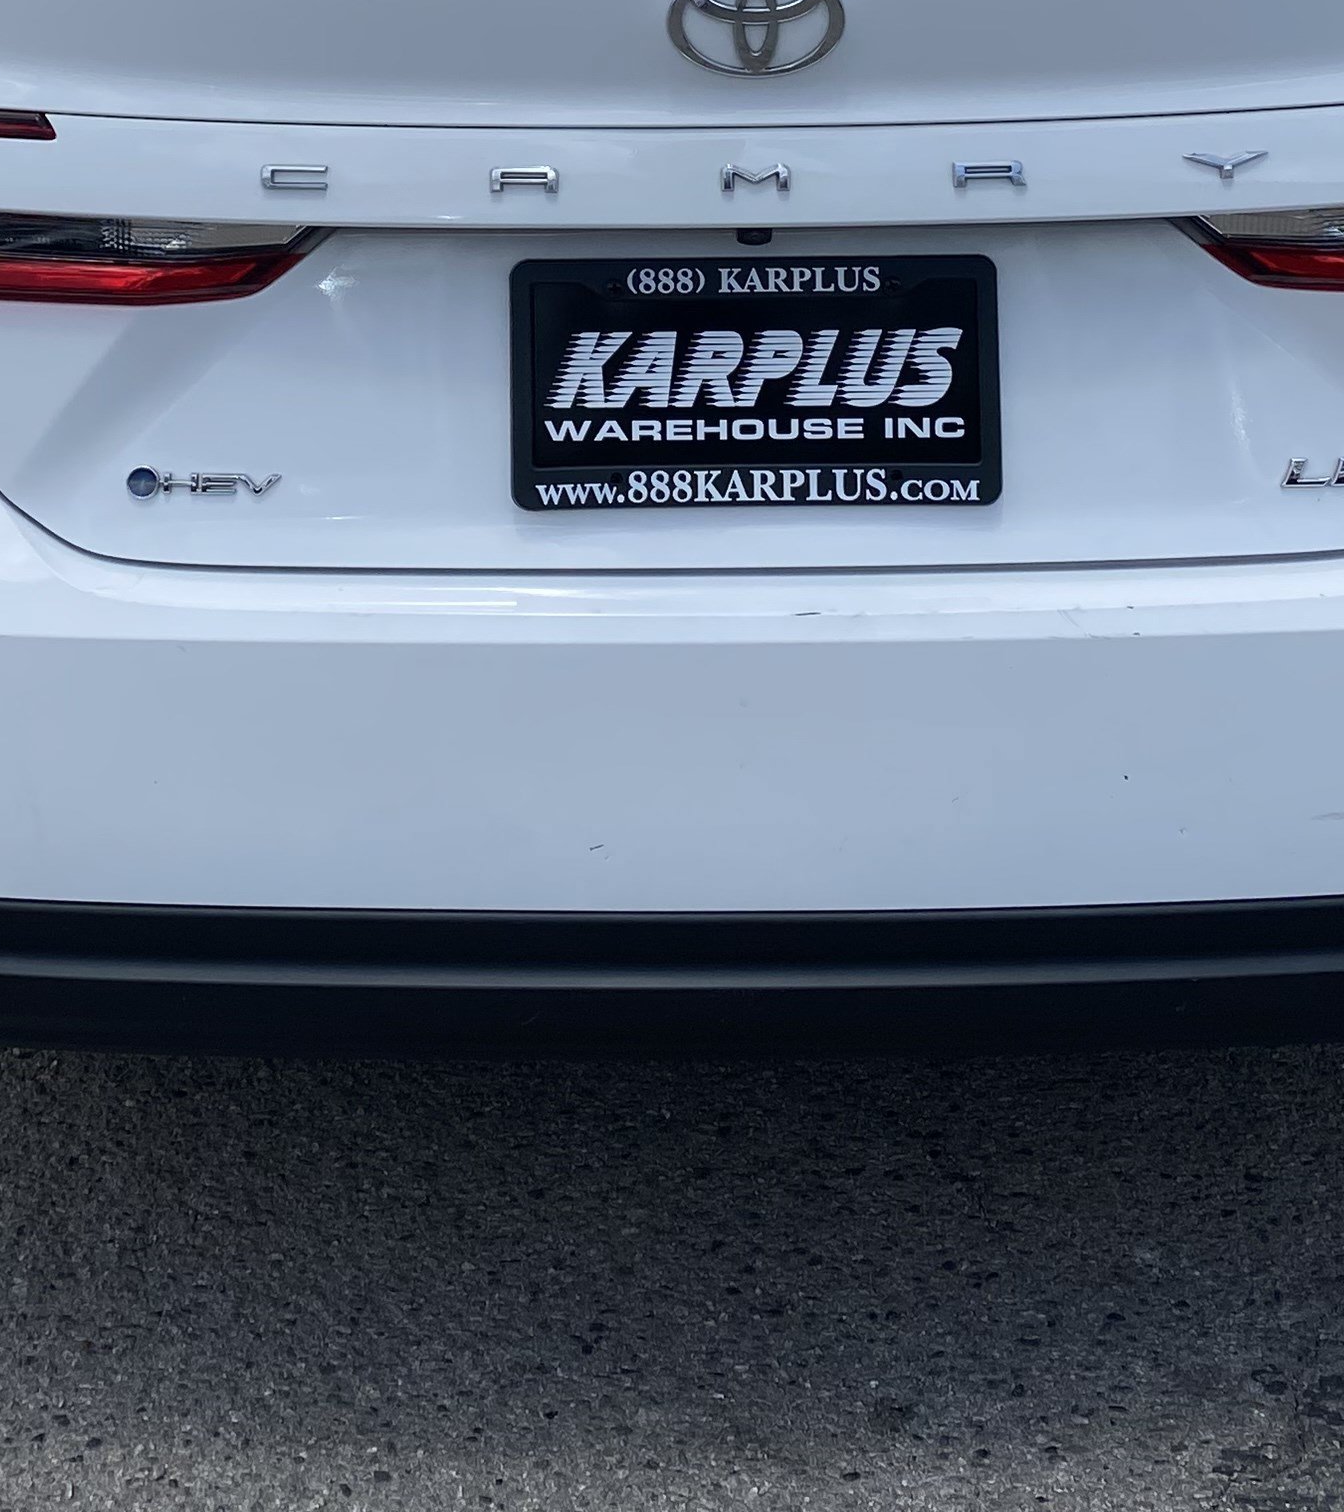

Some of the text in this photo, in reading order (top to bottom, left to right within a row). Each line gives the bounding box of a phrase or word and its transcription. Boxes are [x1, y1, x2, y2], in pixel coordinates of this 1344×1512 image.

[260, 149, 1269, 193] CAMRY
[626, 266, 882, 295] (888) KARPLUS
[544, 327, 963, 409] KARPLUS
[544, 416, 966, 442] WAREHOUSE INC
